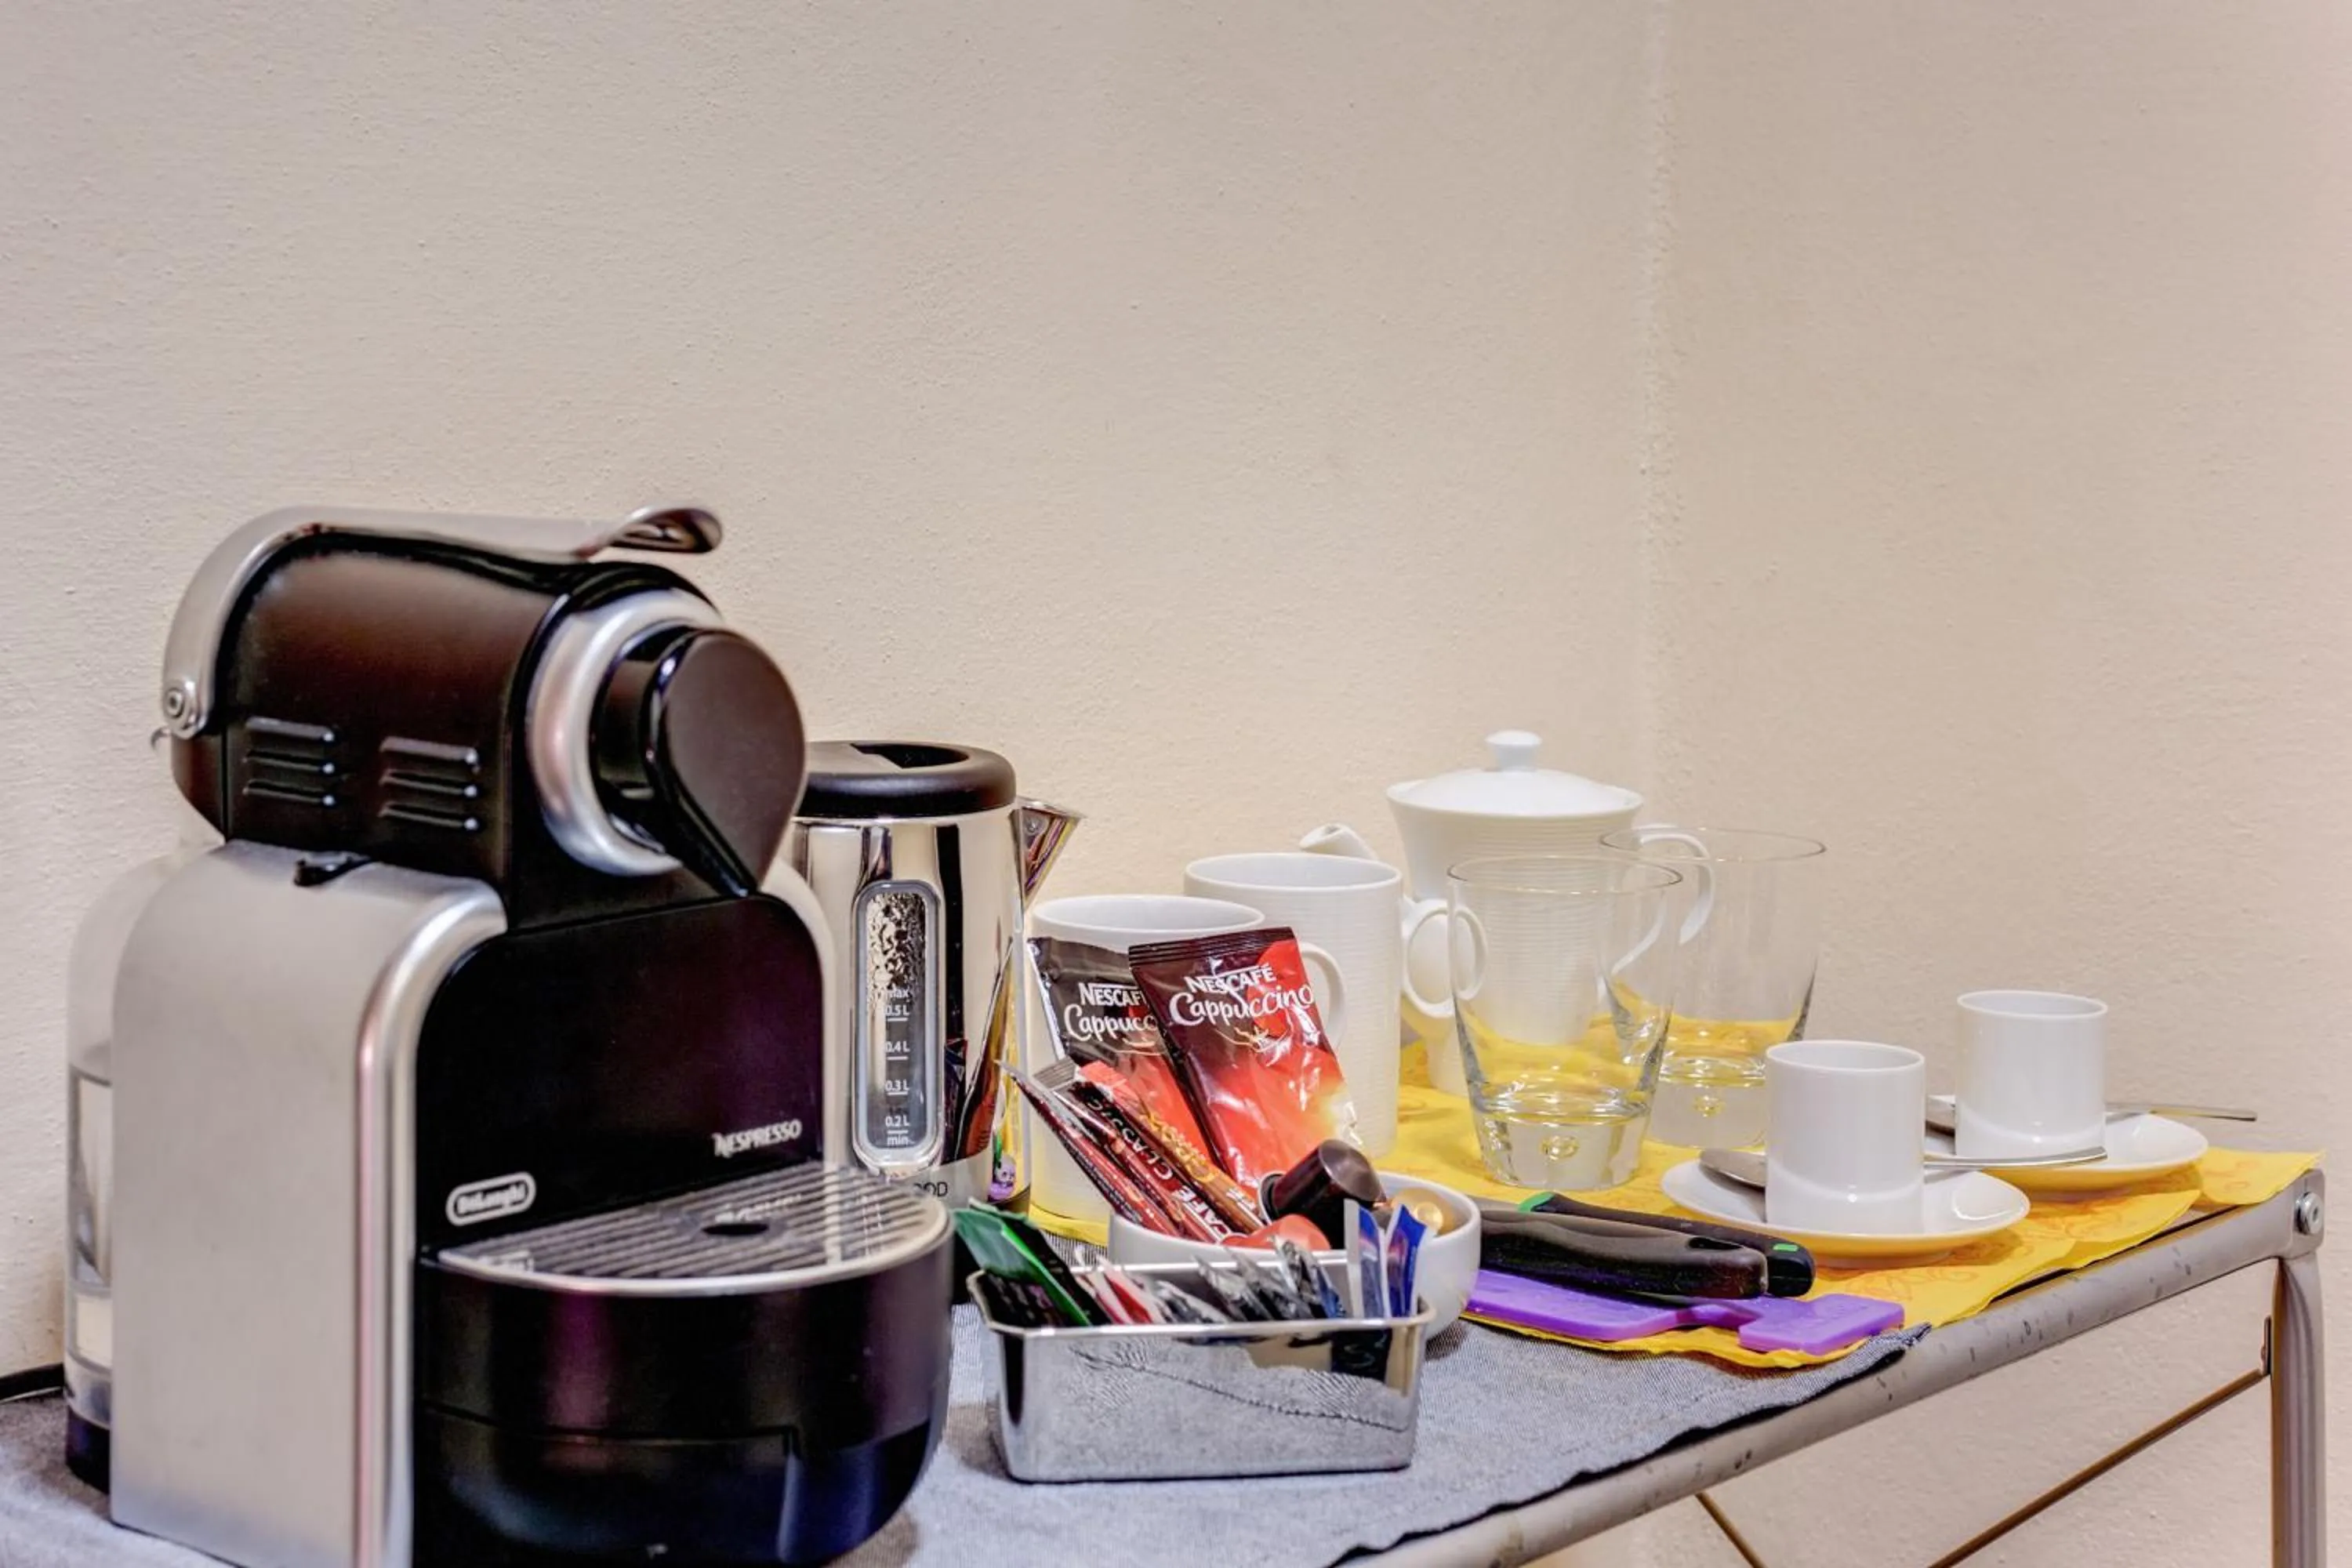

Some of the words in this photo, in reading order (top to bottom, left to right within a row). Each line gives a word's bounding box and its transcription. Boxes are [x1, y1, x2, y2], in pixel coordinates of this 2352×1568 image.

[1063, 1004, 1158, 1042] Cappucc
[1169, 984, 1314, 1026] Cappuccino
[711, 1118, 803, 1159] NESPRESSO
[887, 1134, 909, 1146] min
